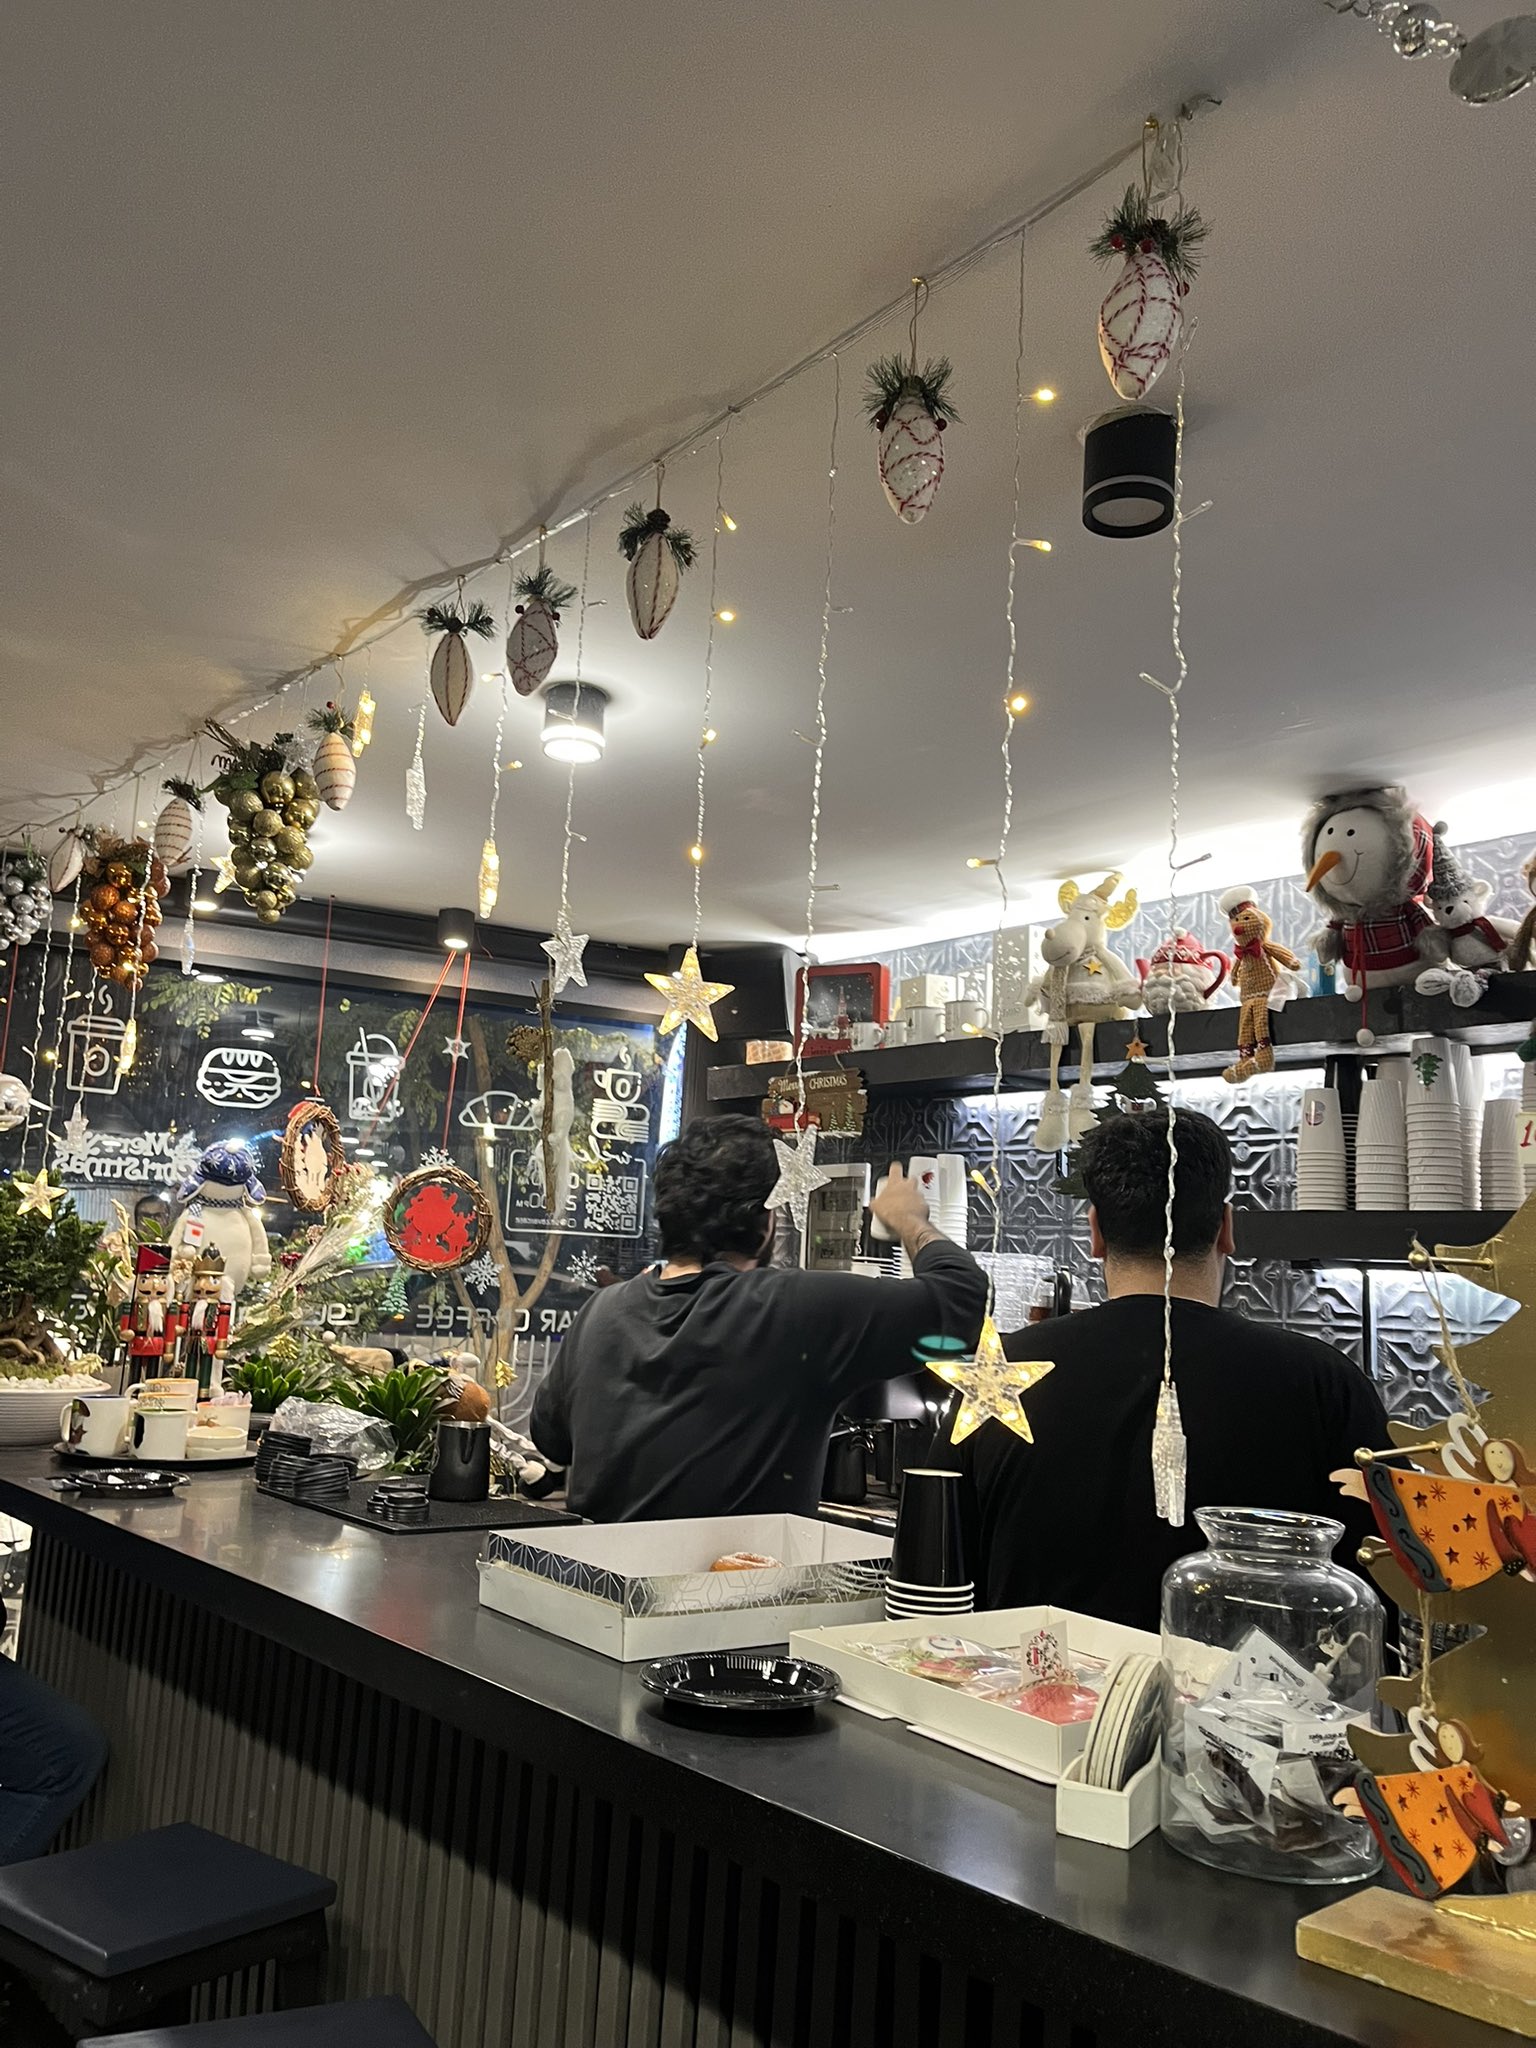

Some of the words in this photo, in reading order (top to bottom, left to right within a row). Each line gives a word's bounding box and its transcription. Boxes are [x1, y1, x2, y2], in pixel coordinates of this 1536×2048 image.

[778, 1079, 799, 1092] Merr
[809, 1075, 848, 1090] CHRISTMAS
[1520, 1120, 1536, 1148] 1
